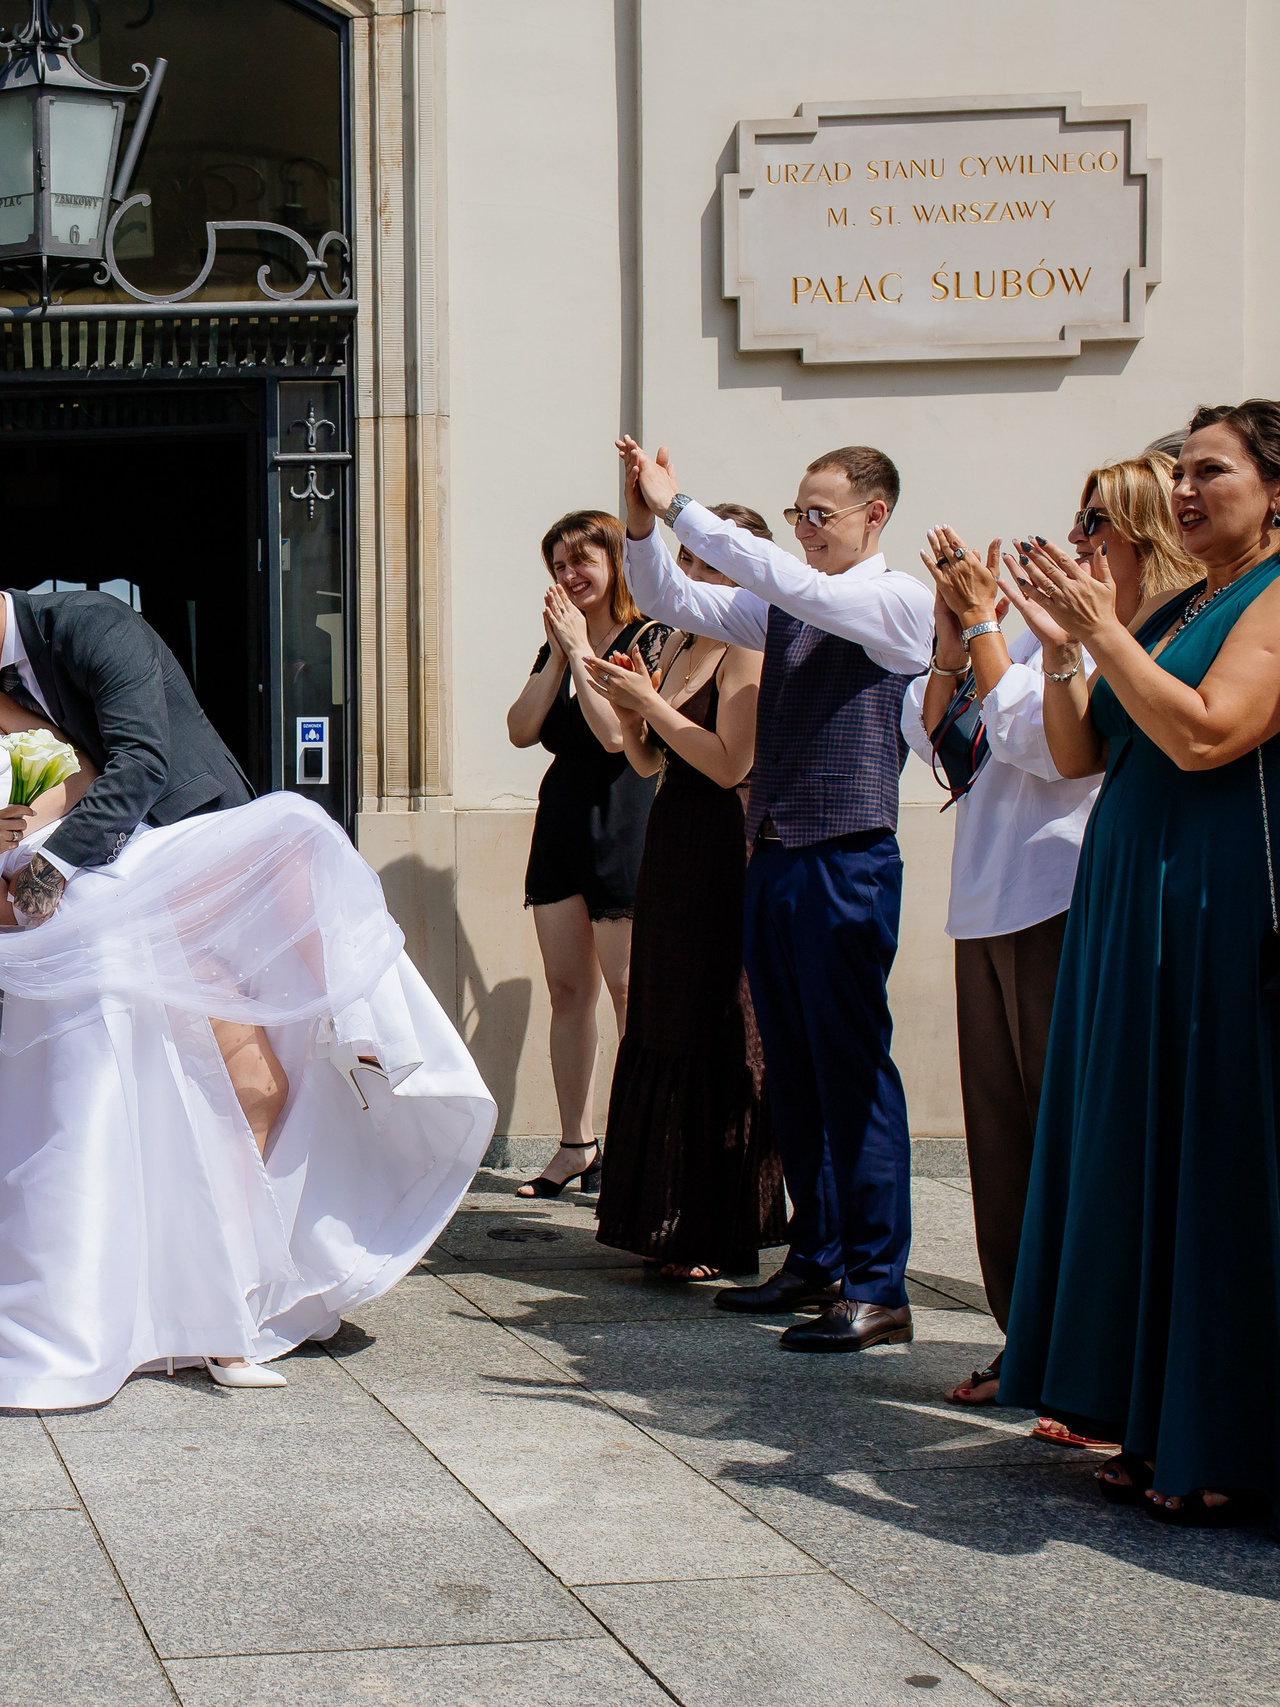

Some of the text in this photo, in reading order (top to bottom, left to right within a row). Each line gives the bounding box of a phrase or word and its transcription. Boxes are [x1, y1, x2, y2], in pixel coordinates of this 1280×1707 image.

[766, 151, 1118, 187] URZĄD STANU CYWILNEGO
[827, 200, 1056, 227] M. ST. WARSZAWY
[69, 224, 81, 245] 6
[792, 258, 1092, 305] PAŁAC ŚLUBÓW
